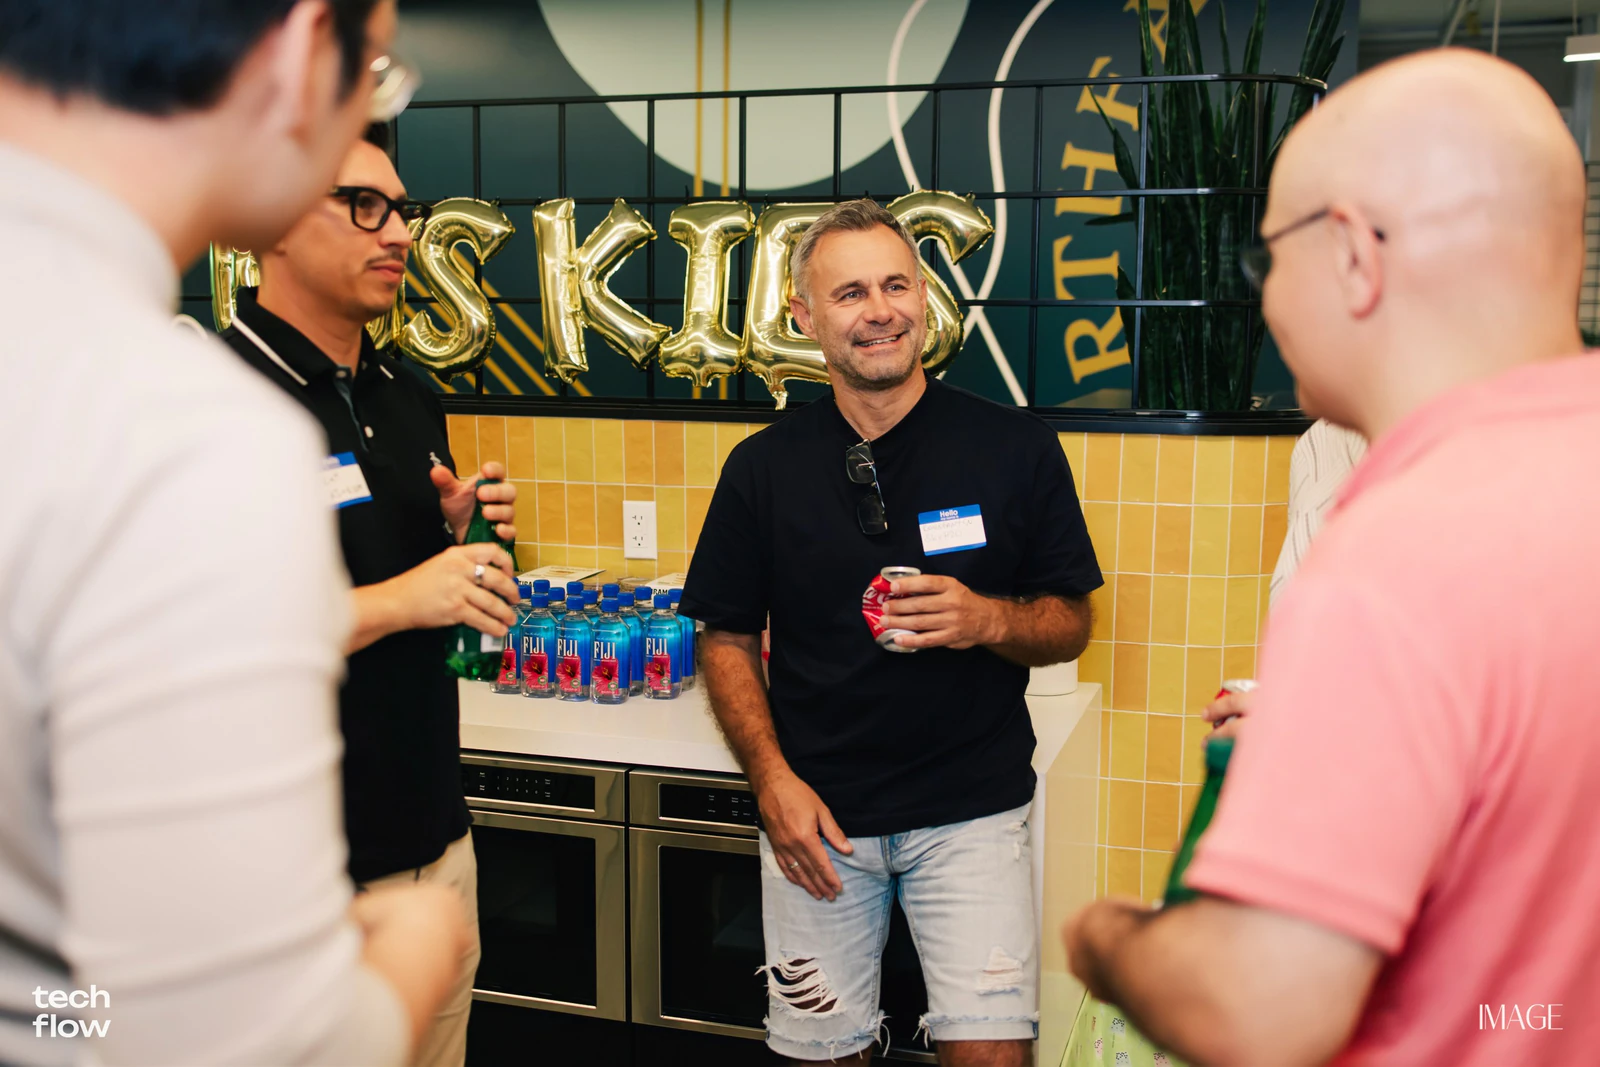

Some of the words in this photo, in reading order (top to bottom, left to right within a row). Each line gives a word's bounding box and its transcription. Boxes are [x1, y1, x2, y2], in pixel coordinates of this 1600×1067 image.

[209, 189, 994, 410] SKIES
[939, 509, 959, 518] Hello
[523, 636, 545, 654] FIJI
[557, 638, 579, 656] FIJI
[594, 641, 616, 659] FIJI
[646, 637, 668, 655] FIJI
